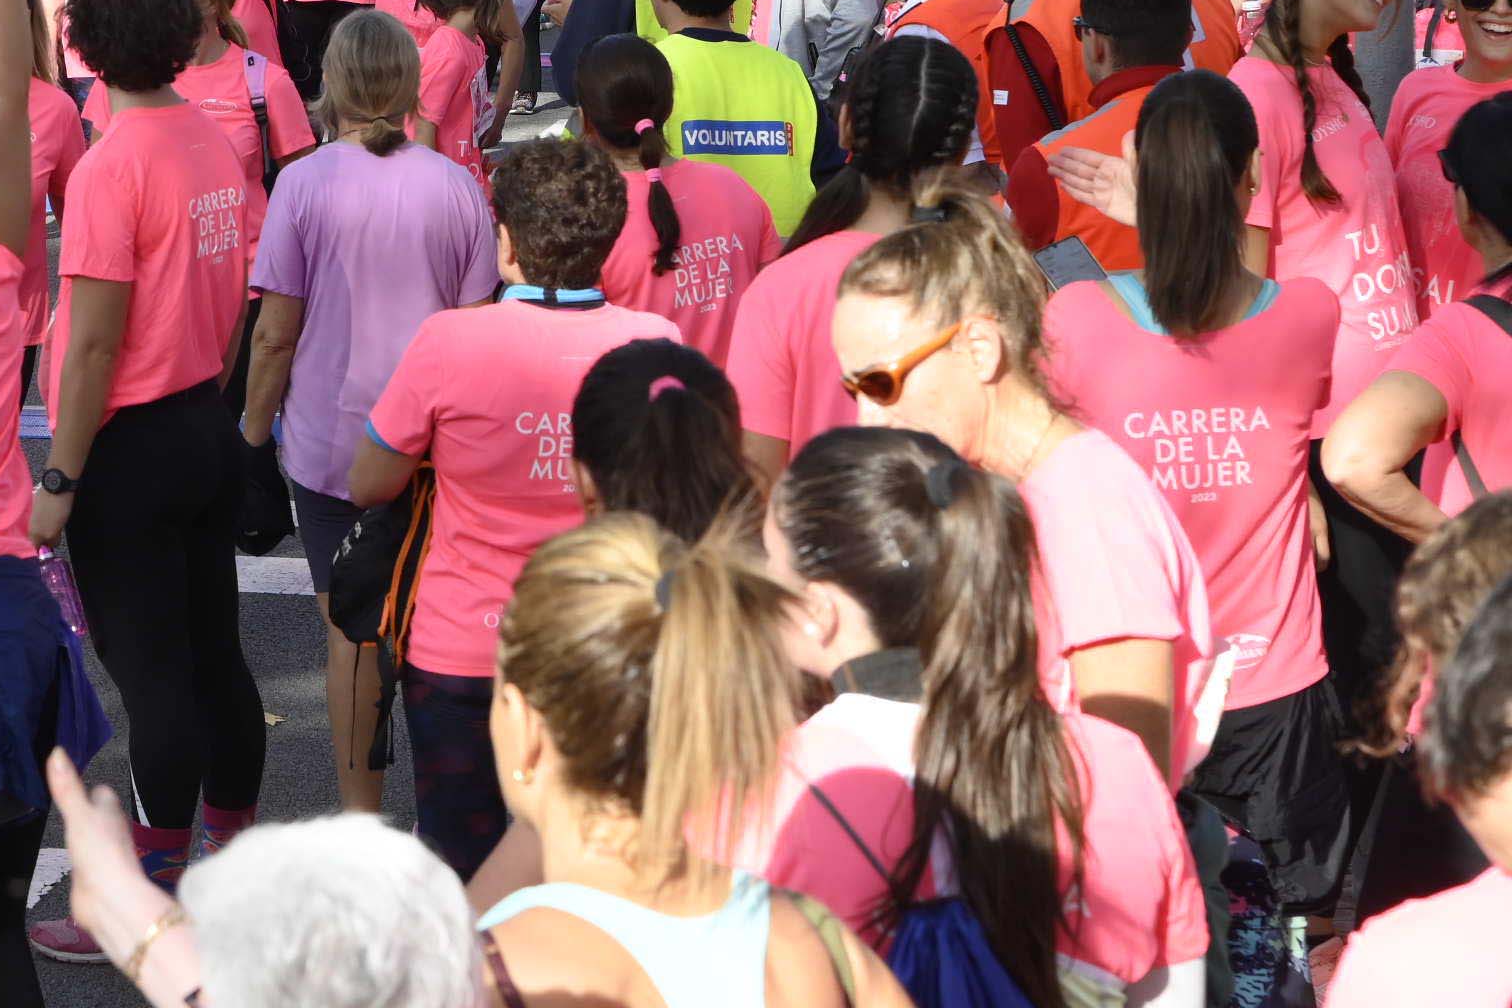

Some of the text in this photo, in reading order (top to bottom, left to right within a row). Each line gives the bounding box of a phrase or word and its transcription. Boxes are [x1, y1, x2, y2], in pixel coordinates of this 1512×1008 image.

[684, 127, 786, 150] VOLUNTARIS
[188, 186, 246, 219] CARRERA
[199, 213, 236, 237] DE LA
[196, 230, 240, 260] MUJER
[674, 259, 731, 288] DE LA
[674, 276, 736, 310] MUJER
[1124, 405, 1271, 439] CARRERA
[538, 437, 573, 458] DE
[1154, 435, 1245, 464] DE LA
[1151, 460, 1253, 491] MUJER
[1190, 492, 1218, 503] 2023
